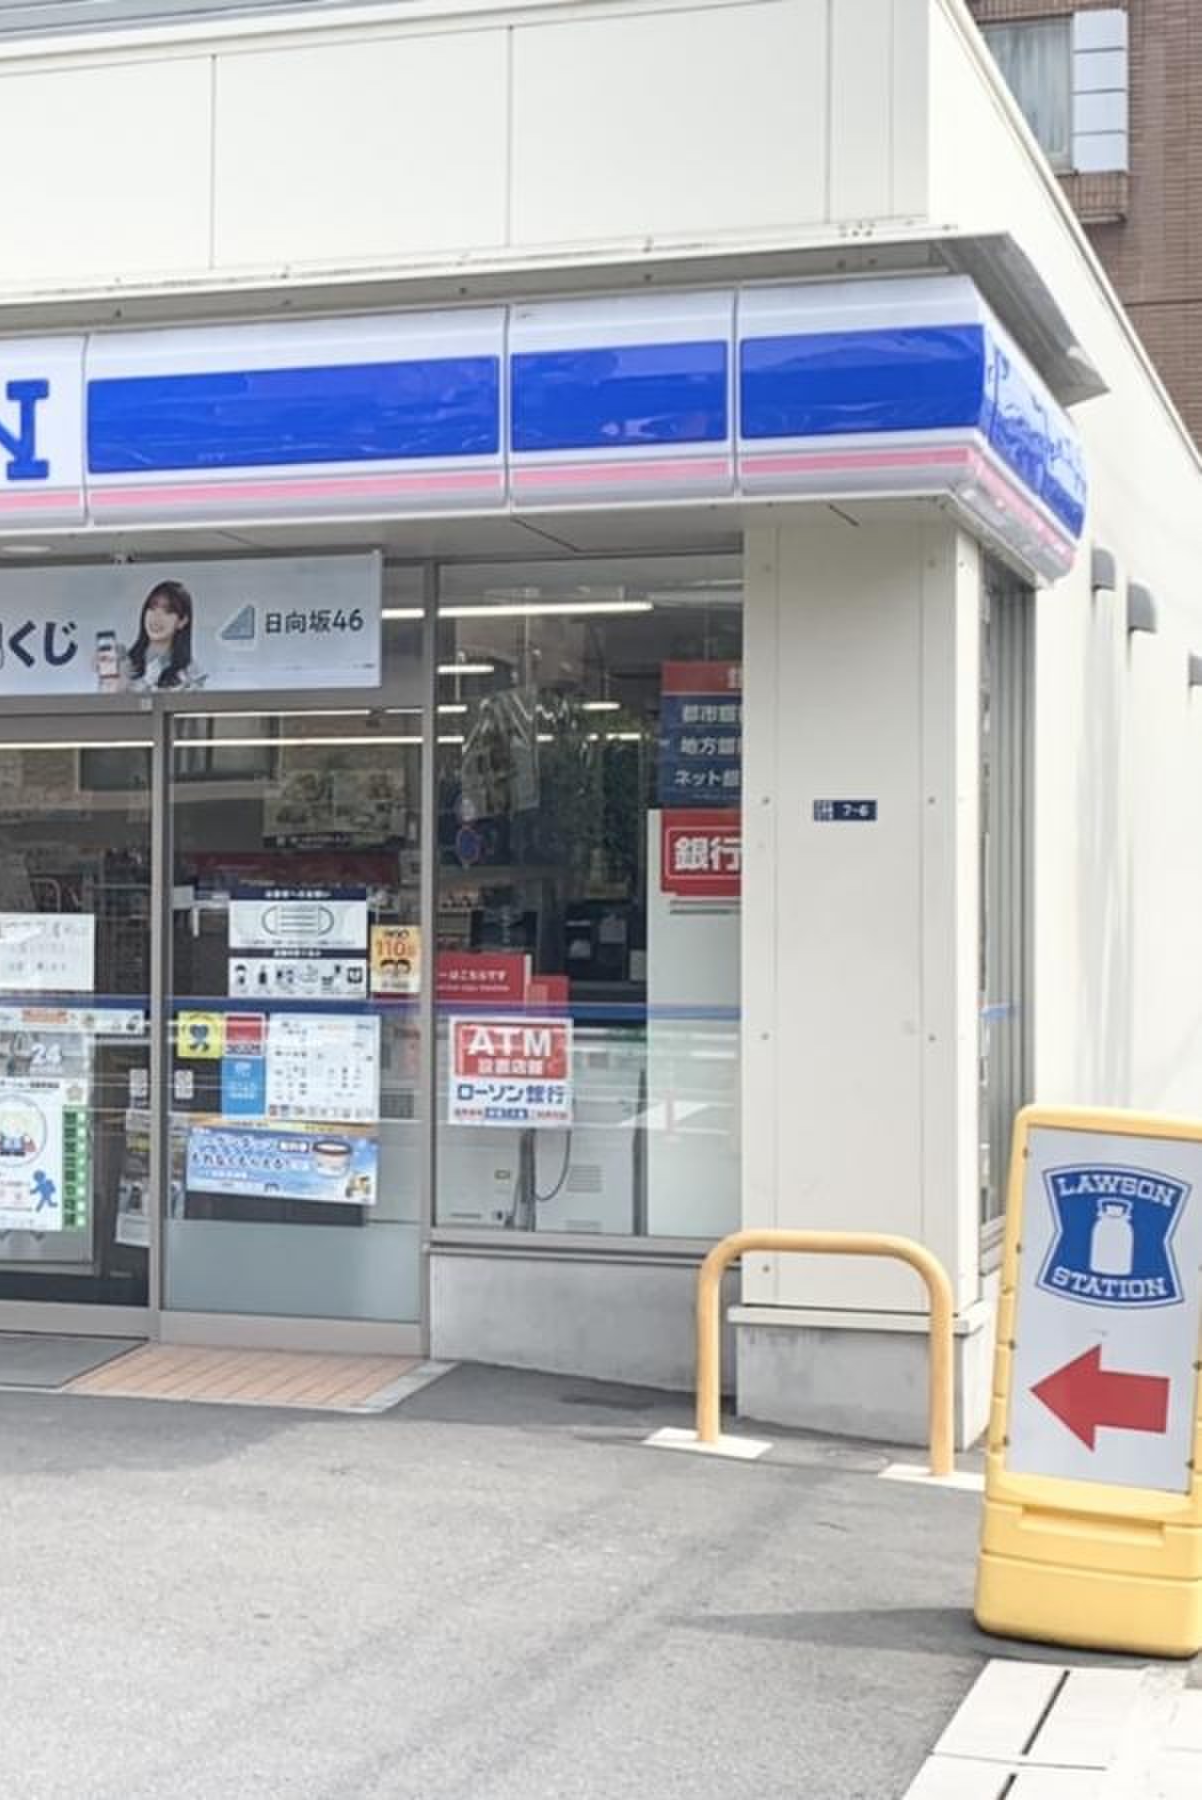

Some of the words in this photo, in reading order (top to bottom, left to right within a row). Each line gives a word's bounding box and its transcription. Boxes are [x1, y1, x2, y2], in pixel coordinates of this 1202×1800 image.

[265, 608, 365, 634] 日向坂46
[8, 620, 79, 668] くじ
[467, 1025, 552, 1058] ATM
[456, 1083, 565, 1105] ローソン銀行
[1055, 1174, 1177, 1208] LAWSON
[1051, 1266, 1167, 1299] STATION
